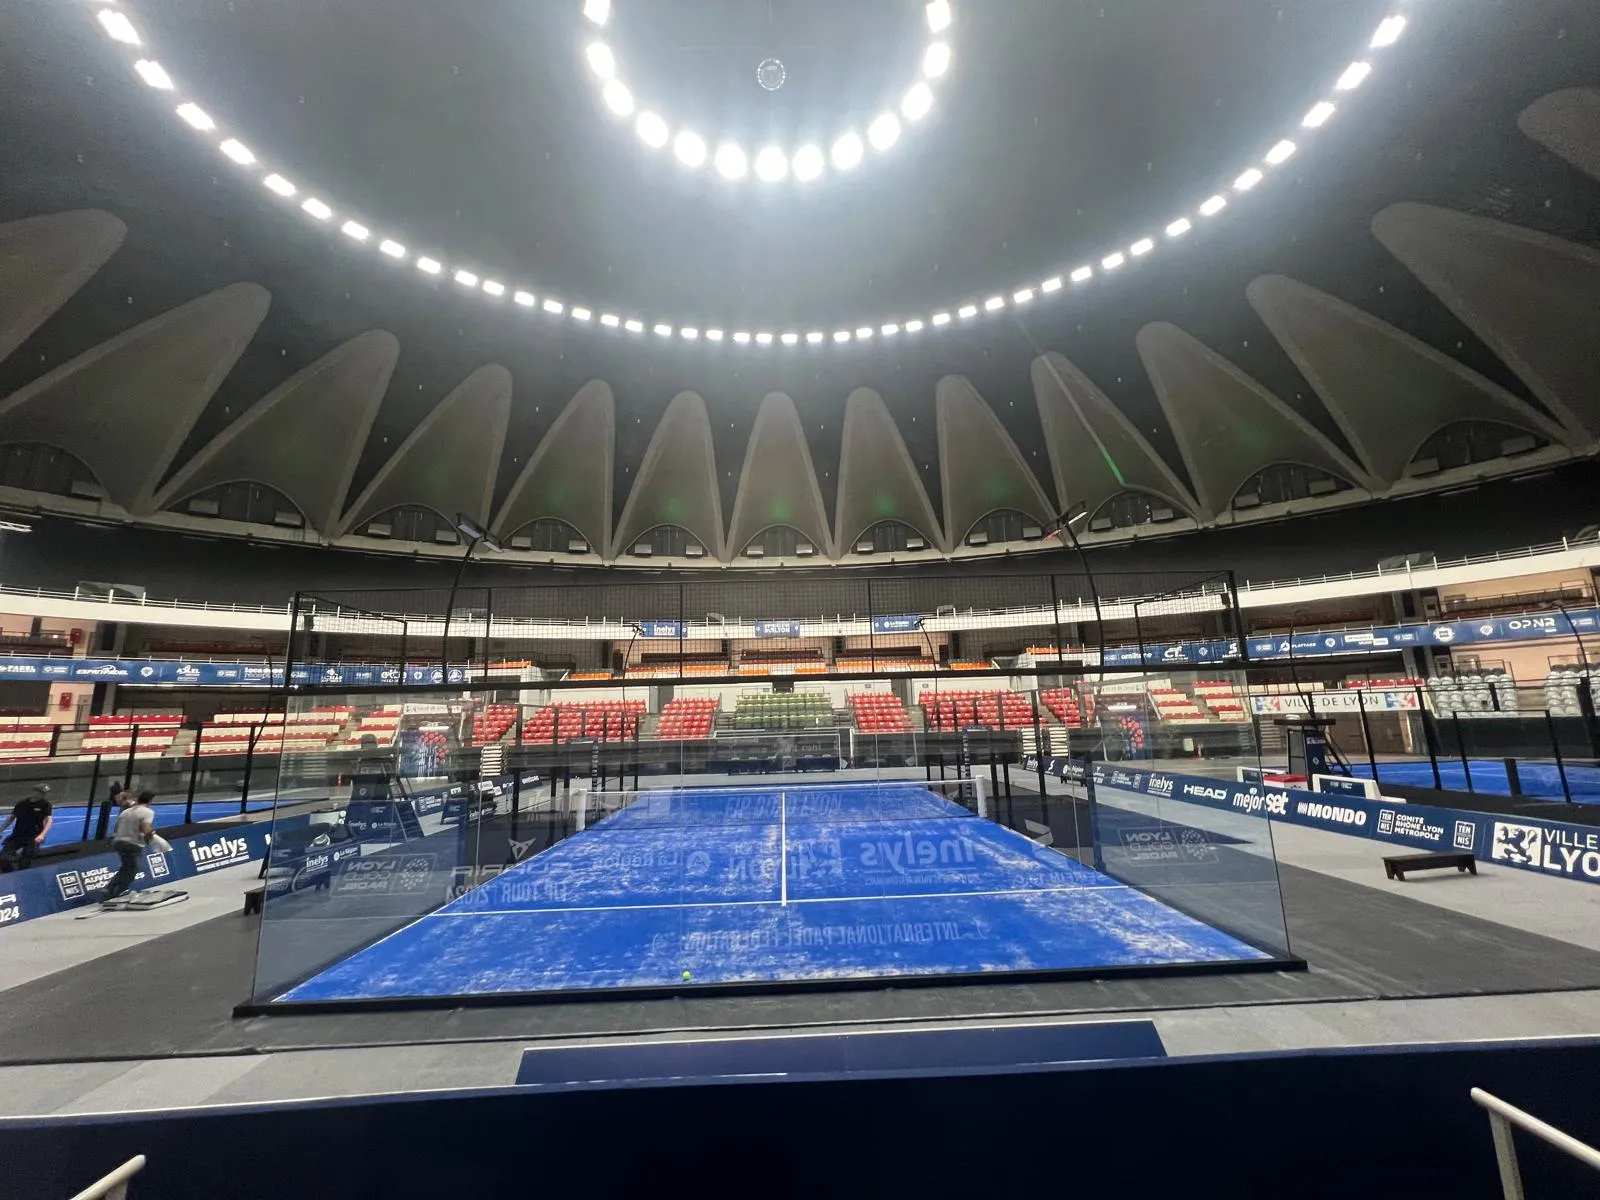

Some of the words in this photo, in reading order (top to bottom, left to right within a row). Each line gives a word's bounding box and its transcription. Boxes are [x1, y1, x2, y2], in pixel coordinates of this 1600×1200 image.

[1285, 696, 1317, 708] VILLE
[1322, 696, 1336, 706] DE
[1344, 695, 1380, 707] LYON
[1149, 773, 1174, 793] inelys
[1184, 784, 1227, 800] HEAD
[1307, 802, 1367, 825] MONDO
[1423, 824, 1444, 835] LYON
[1458, 825, 1471, 834] TEN
[1457, 836, 1470, 846] NIS
[1544, 828, 1599, 850] VILLE
[189, 836, 248, 862] inelys
[305, 853, 330, 869] inelys
[81, 867, 110, 878] LIGUE
